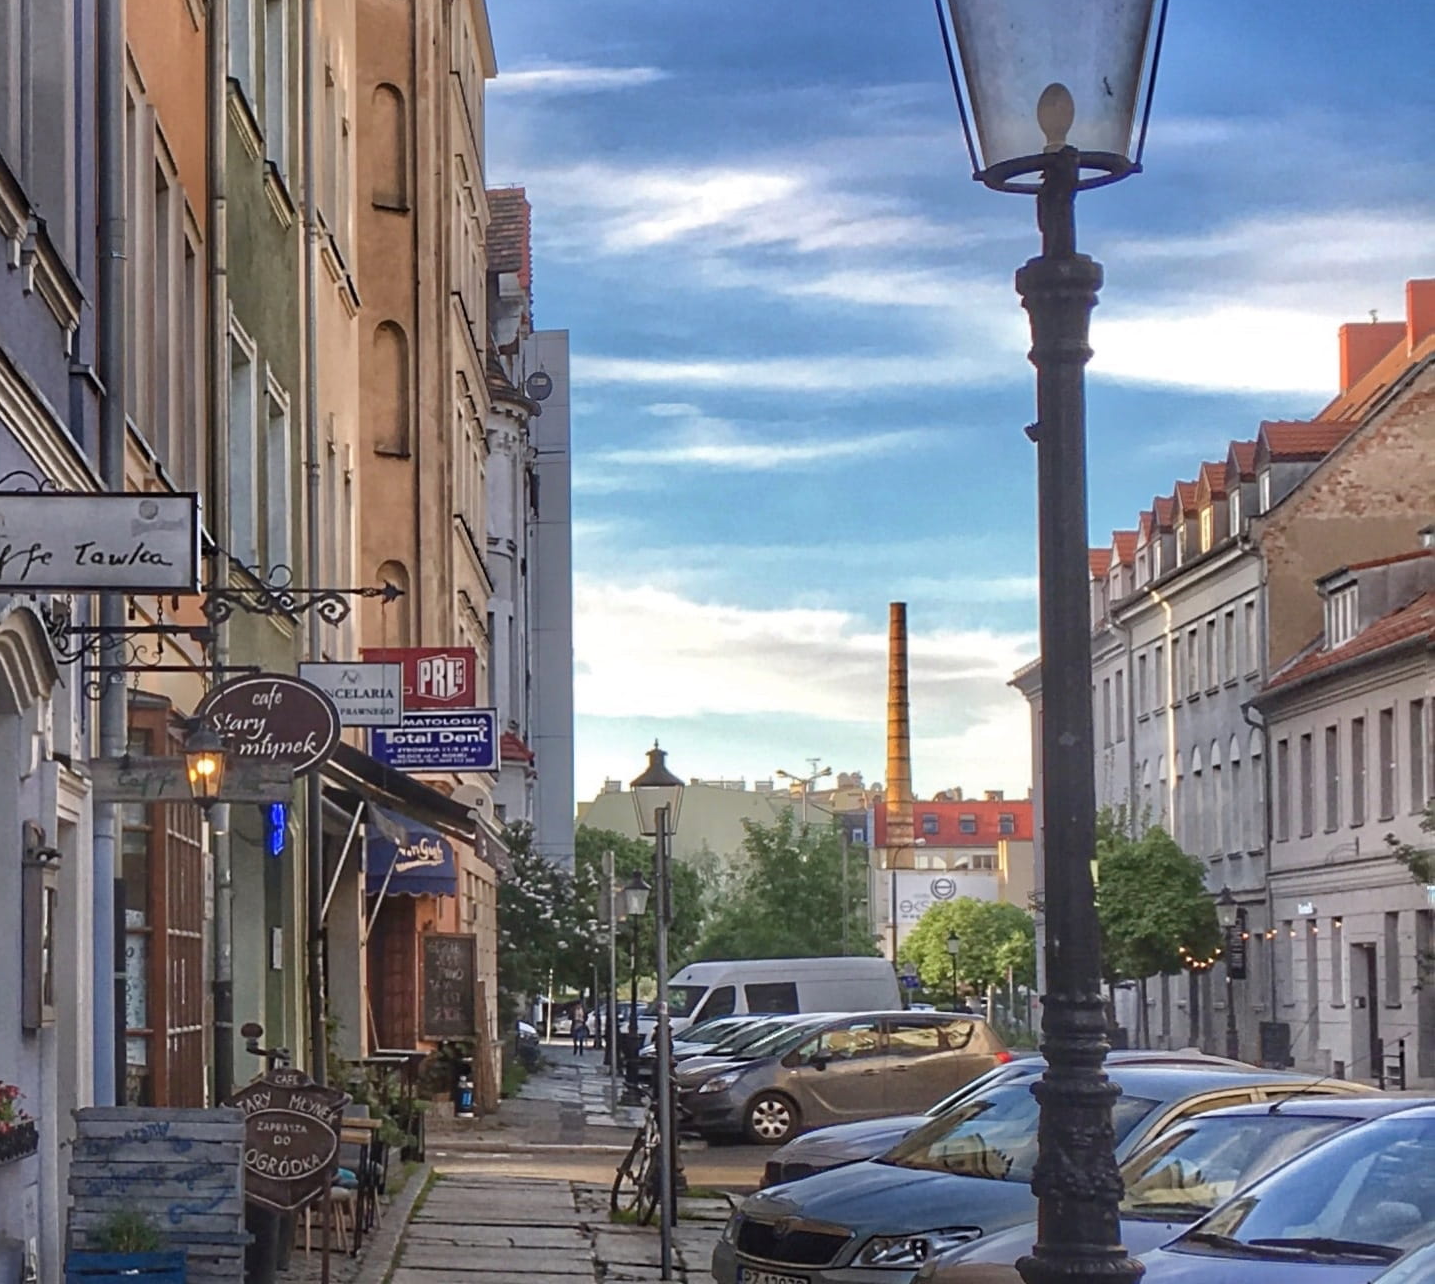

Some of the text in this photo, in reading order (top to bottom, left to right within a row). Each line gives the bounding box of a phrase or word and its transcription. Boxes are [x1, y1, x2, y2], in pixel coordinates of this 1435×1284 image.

[420, 658, 458, 698] PRL
[252, 684, 282, 710] cafe
[324, 688, 394, 699] NCELARIA
[213, 713, 266, 739] Stary
[403, 717, 487, 726] MATOLOGIA
[239, 732, 318, 759] młynek
[385, 728, 488, 744] Total Dent
[275, 1075, 298, 1085] CAFE
[221, 1092, 271, 1114] TARY
[273, 1136, 291, 1145] DO
[245, 1149, 321, 1176] OGRÓDKA
